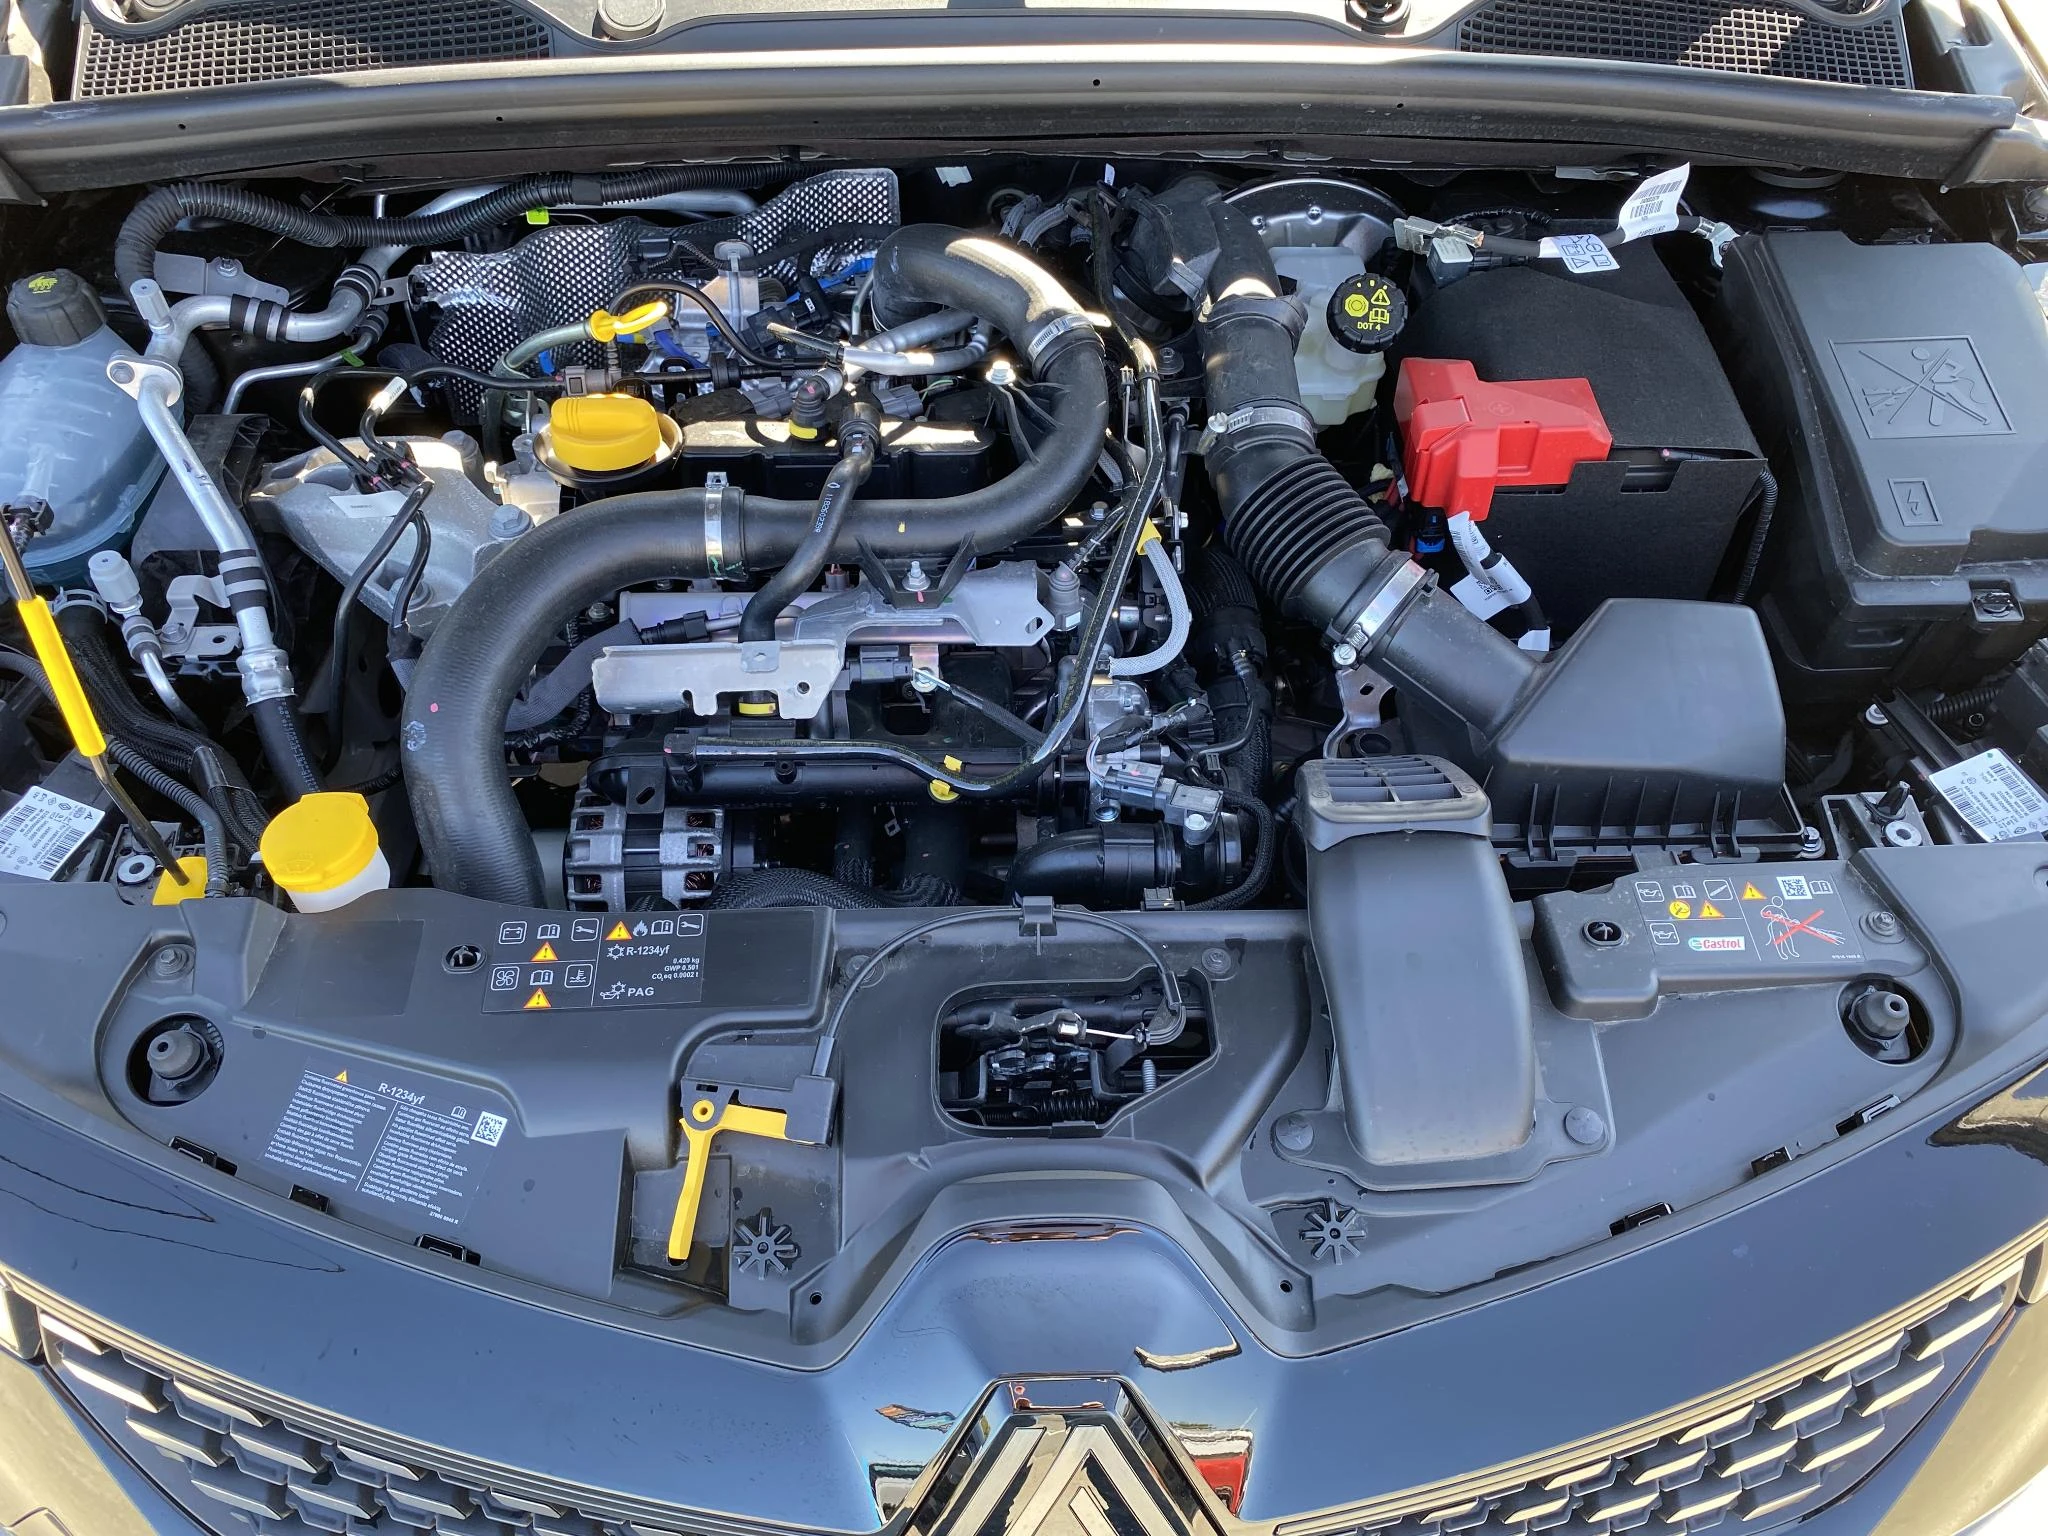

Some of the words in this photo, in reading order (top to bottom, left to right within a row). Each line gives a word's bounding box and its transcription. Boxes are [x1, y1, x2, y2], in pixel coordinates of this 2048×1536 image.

[1357, 321, 1373, 330] DOT
[1703, 939, 1742, 949] Castrol
[626, 945, 670, 956] R-1234yf
[691, 957, 700, 965] kg
[627, 986, 654, 998] PAG
[377, 1082, 425, 1105] R-1234yf
